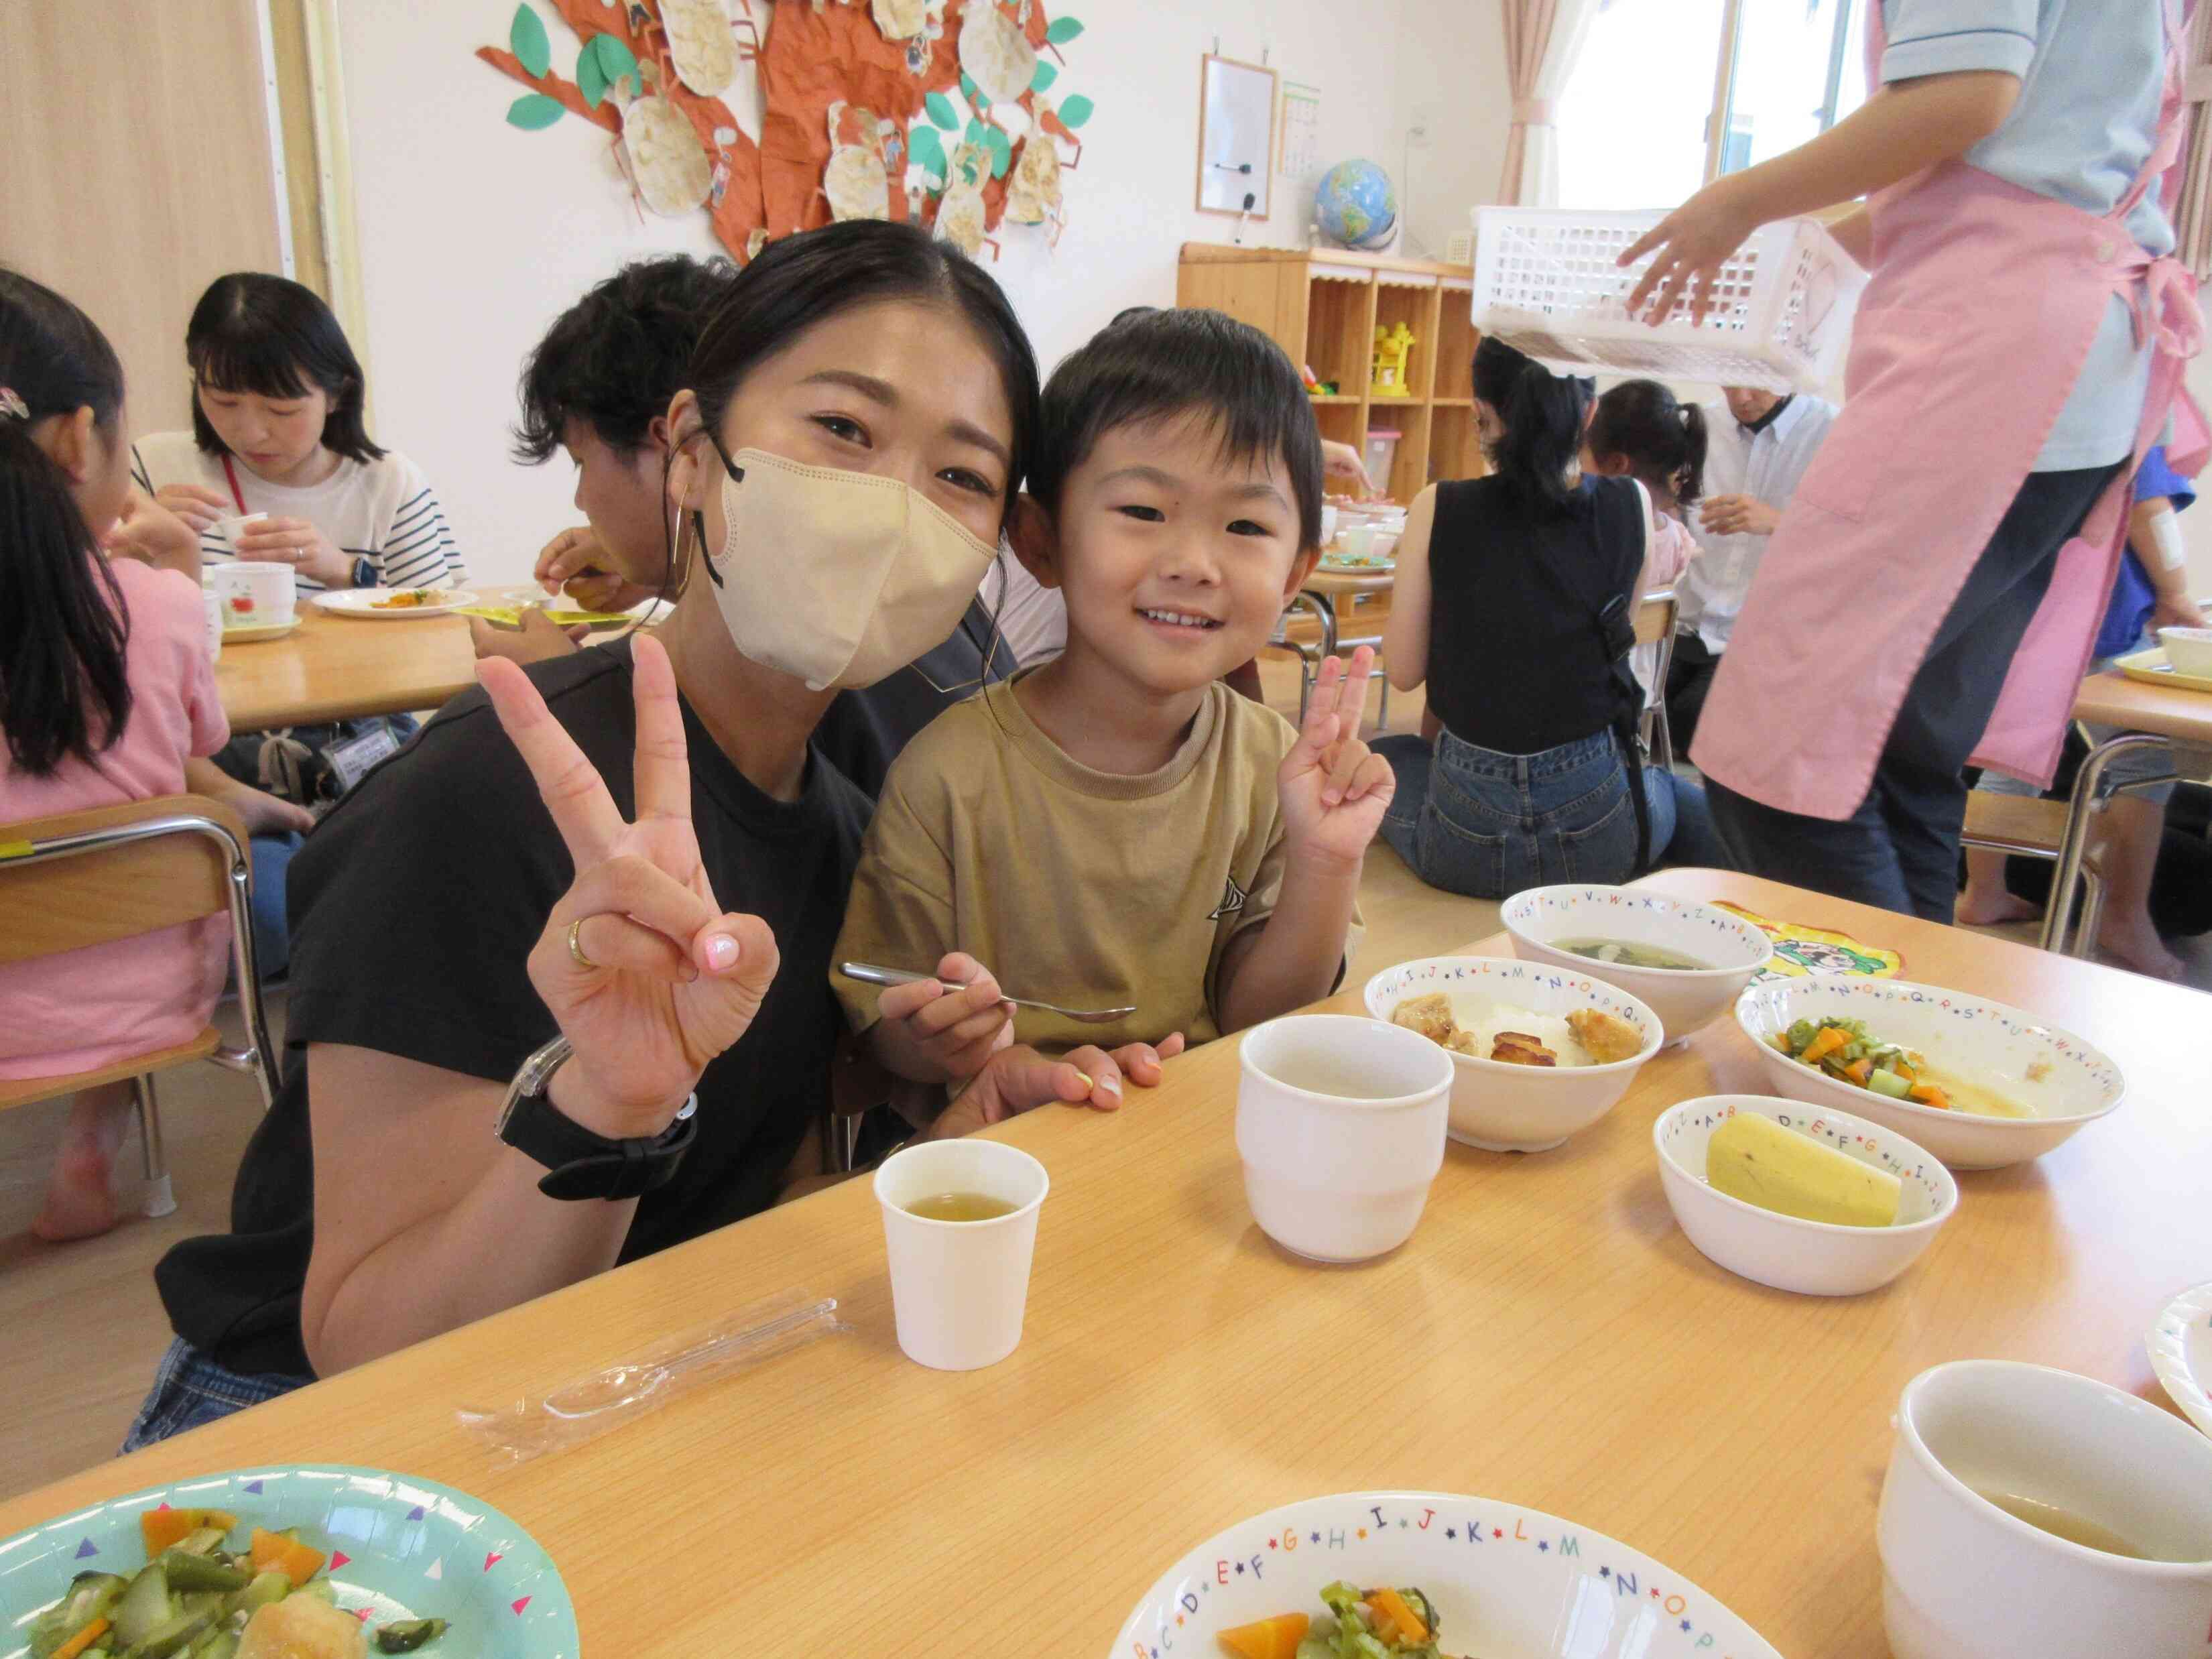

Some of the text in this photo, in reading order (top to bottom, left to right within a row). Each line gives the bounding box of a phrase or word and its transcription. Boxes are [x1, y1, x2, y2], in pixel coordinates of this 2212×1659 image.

[1561, 901, 1569, 910] U
[1586, 891, 1593, 901] V
[1642, 898, 1652, 908] X
[1695, 908, 1703, 918] Z
[1719, 921, 1726, 932] A
[1406, 970, 1414, 982] I
[1428, 966, 1437, 978] J
[1455, 967, 1465, 979] K
[1482, 962, 1491, 973] L
[1512, 967, 1523, 978] M
[1550, 976, 1562, 989] N
[1580, 981, 1591, 992] O
[1623, 1007, 1634, 1020] Q
[1863, 983, 1873, 994] O
[1911, 991, 1925, 1003] Q
[1939, 999, 1951, 1010] R
[1963, 1008, 1973, 1019] S
[1705, 1115, 1714, 1128] A
[1778, 1115, 1790, 1127] D
[1811, 1119, 1825, 1133] E
[1839, 1135, 1849, 1149] F
[1865, 1139, 1877, 1152] G
[1889, 1158, 1902, 1174] H
[1915, 1164, 1924, 1178] I
[1161, 1625, 1173, 1650] C
[1181, 1593, 1199, 1614] D
[1217, 1560, 1229, 1585] E
[1250, 1553, 1264, 1579] F
[1283, 1527, 1298, 1552] G
[1329, 1527, 1346, 1550] H
[1369, 1506, 1388, 1529] I
[1417, 1508, 1436, 1530] J
[1467, 1520, 1483, 1543] K
[1514, 1518, 1528, 1540] L
[1558, 1534, 1580, 1558] M
[1616, 1572, 1638, 1597] N
[1664, 1594, 1686, 1615] O
[1694, 1633, 1713, 1649] P
